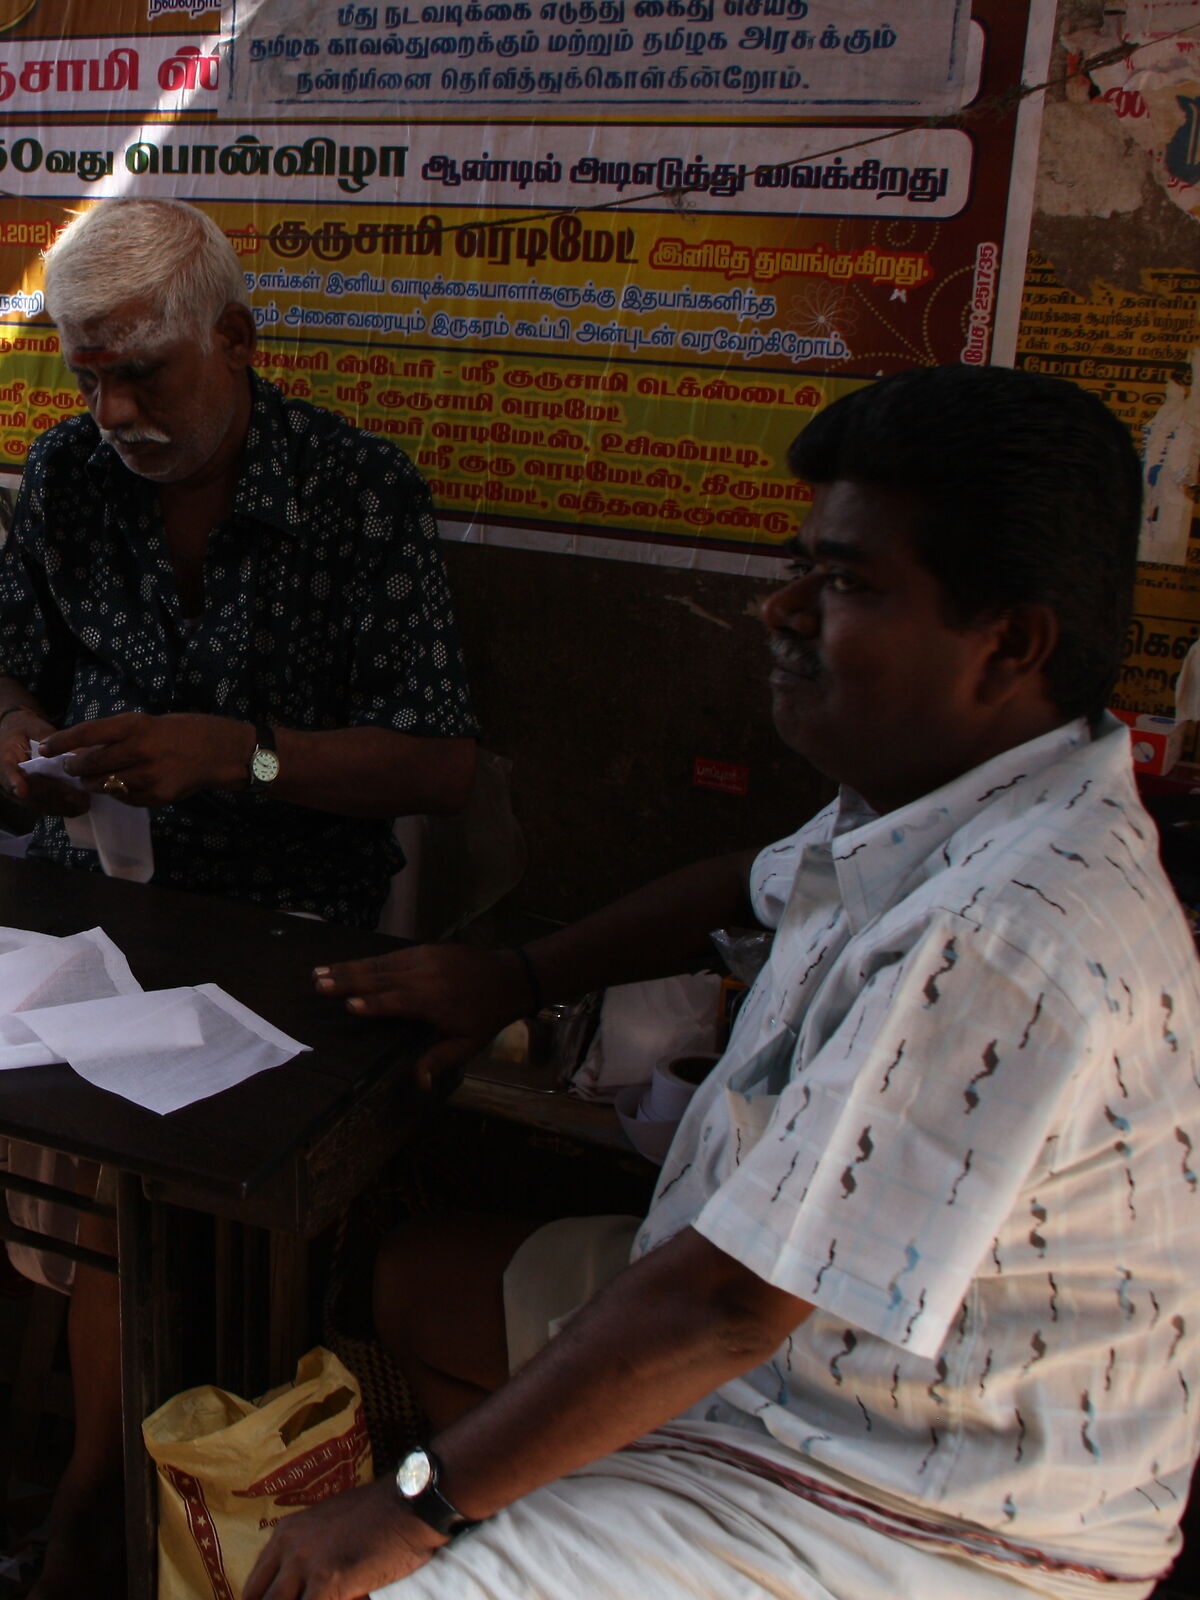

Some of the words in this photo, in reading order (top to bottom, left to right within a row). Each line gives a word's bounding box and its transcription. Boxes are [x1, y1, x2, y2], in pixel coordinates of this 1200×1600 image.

[250, 34, 320, 61] தமிழக
[328, 30, 539, 60] காவல்துறைக்கும்
[549, 28, 633, 57] மற்றும்
[643, 26, 727, 55] தமிழக
[738, 23, 897, 54] அரசுக்கும்
[298, 67, 432, 95] நன்றியினை
[125, 134, 409, 193] பொன்விழா
[421, 152, 562, 190] ஆண்டில்
[755, 157, 949, 202] வைக்கிறது
[269, 214, 443, 261] குருசாமி
[455, 215, 639, 267] ரெடிமேட்
[652, 241, 751, 278] இனிதே
[260, 268, 320, 289] எங்கள்
[326, 272, 385, 294] இனிய
[391, 275, 616, 308] வாடிக்கையாளர்களுக்கு
[623, 286, 776, 317] இதயங்கனிந்த
[285, 306, 426, 334] அனைவரையும்
[432, 313, 510, 339] இருகரம்
[515, 317, 570, 340] கூப்பி
[576, 322, 676, 350] அன்புடன்
[336, 355, 436, 378] ஸ்டோர்
[462, 359, 499, 386] ஸ்ரீ
[503, 370, 629, 392] குருசாமி
[336, 381, 372, 406] ஸ்ரீ
[377, 389, 493, 412] குருசாமி
[418, 445, 454, 470] ஸ்ரீ
[458, 455, 516, 477] குரு
